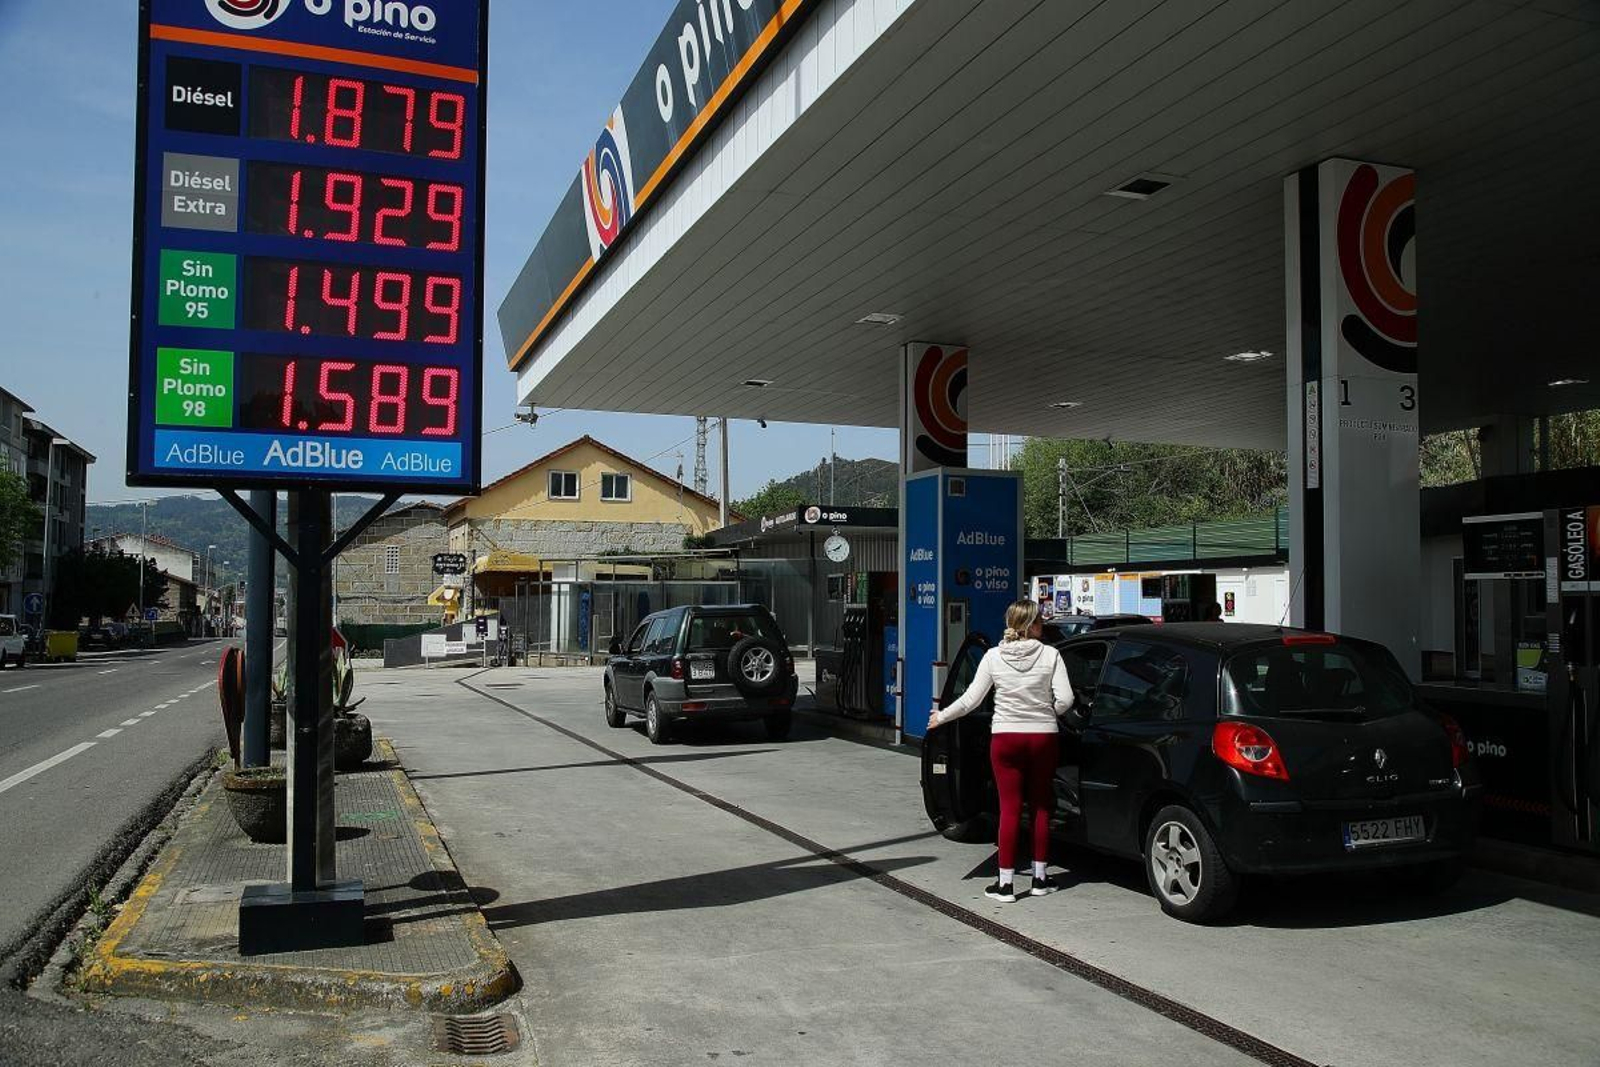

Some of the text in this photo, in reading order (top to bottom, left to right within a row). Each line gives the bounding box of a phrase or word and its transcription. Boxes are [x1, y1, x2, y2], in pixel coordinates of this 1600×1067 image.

[344, 0, 437, 32] pino
[357, 25, 437, 45] Estación de Servicio
[172, 86, 234, 108] Diésel
[656, 63, 674, 123] o
[290, 76, 465, 160] 1.879
[170, 170, 231, 192] Diésel
[173, 196, 226, 216] Extra
[288, 171, 463, 250] 1.929
[182, 260, 213, 278] Sin
[166, 280, 229, 299] Plomo
[184, 302, 209, 319] 95
[284, 266, 461, 344] 1.499
[179, 358, 210, 375] Sin
[163, 378, 226, 397] Plomo
[1340, 379, 1352, 406] 1
[281, 361, 459, 436] 1.589
[1399, 385, 1416, 411] 3
[182, 401, 206, 417] 98
[166, 439, 452, 472] AdBlue AdBlue AdBlue
[829, 511, 847, 521] pino
[957, 531, 1006, 546] AdBlue
[1564, 510, 1584, 579] GASÓLEO A
[910, 548, 934, 562] AdBlue
[975, 566, 1009, 578] o pino
[922, 581, 936, 594] pino
[974, 578, 1009, 590] o viso
[922, 594, 936, 605] viso
[1477, 740, 1507, 758] pino
[1350, 818, 1421, 841] 5522 FHY
